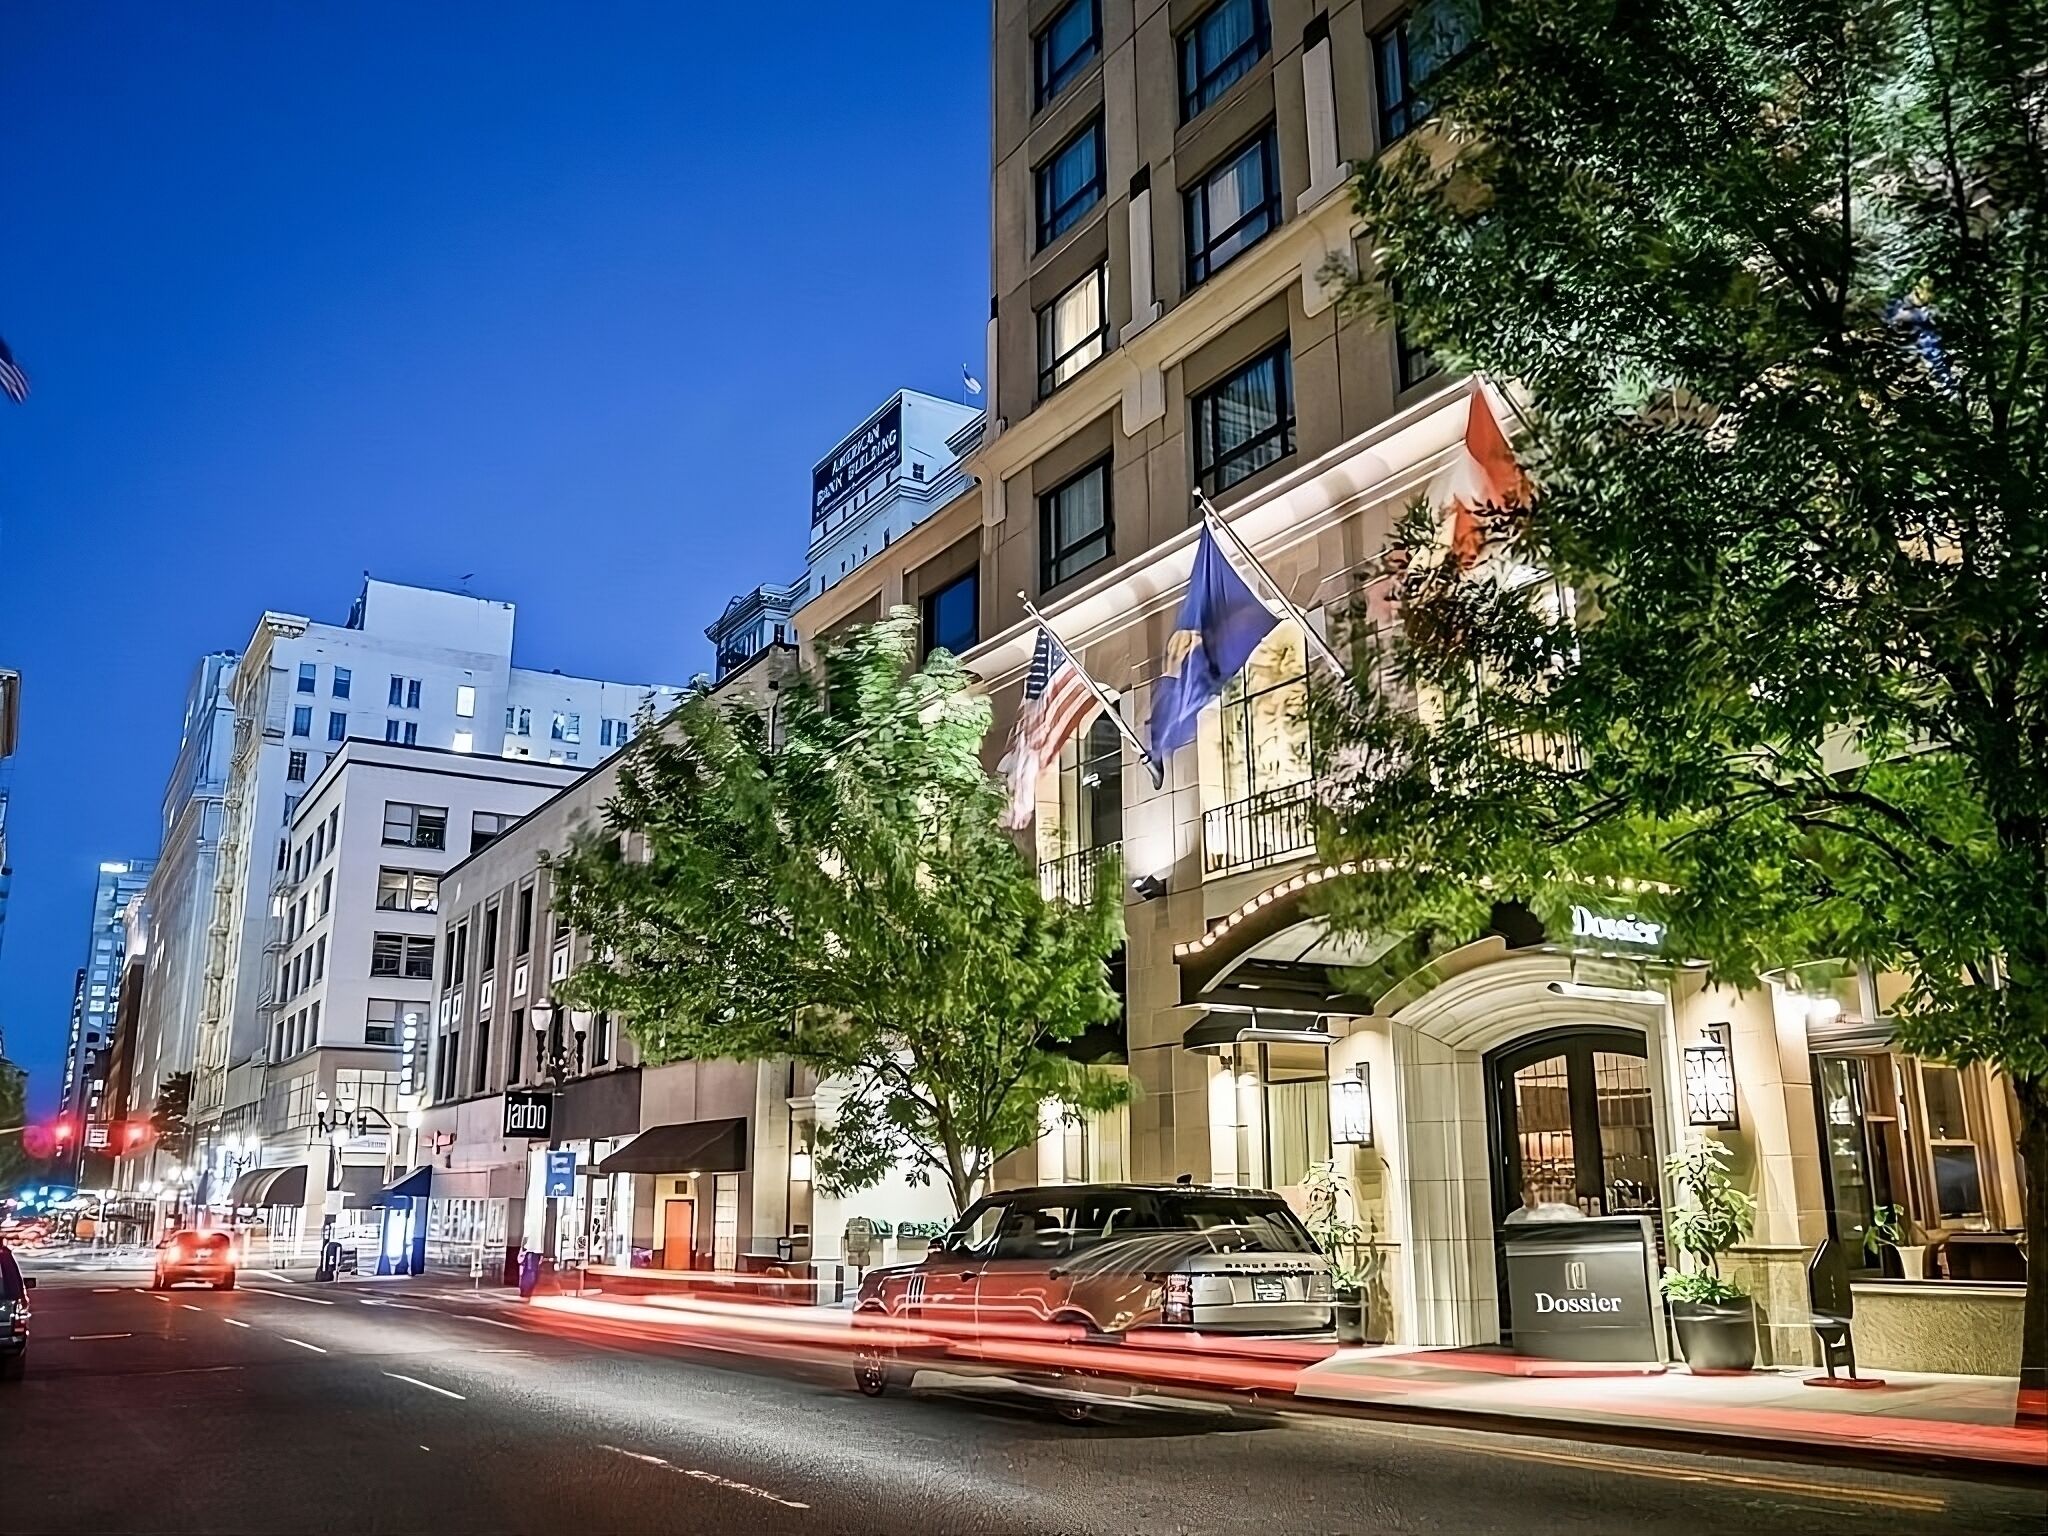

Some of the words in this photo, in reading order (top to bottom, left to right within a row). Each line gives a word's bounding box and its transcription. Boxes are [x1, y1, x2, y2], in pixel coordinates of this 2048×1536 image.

[817, 473, 843, 507] BANK
[848, 429, 897, 480] BUILDING
[832, 424, 880, 476] AMERICAN
[1570, 904, 1661, 945] Dossier
[505, 1096, 547, 1134] jarbo
[1534, 1292, 1622, 1314] Dossier
